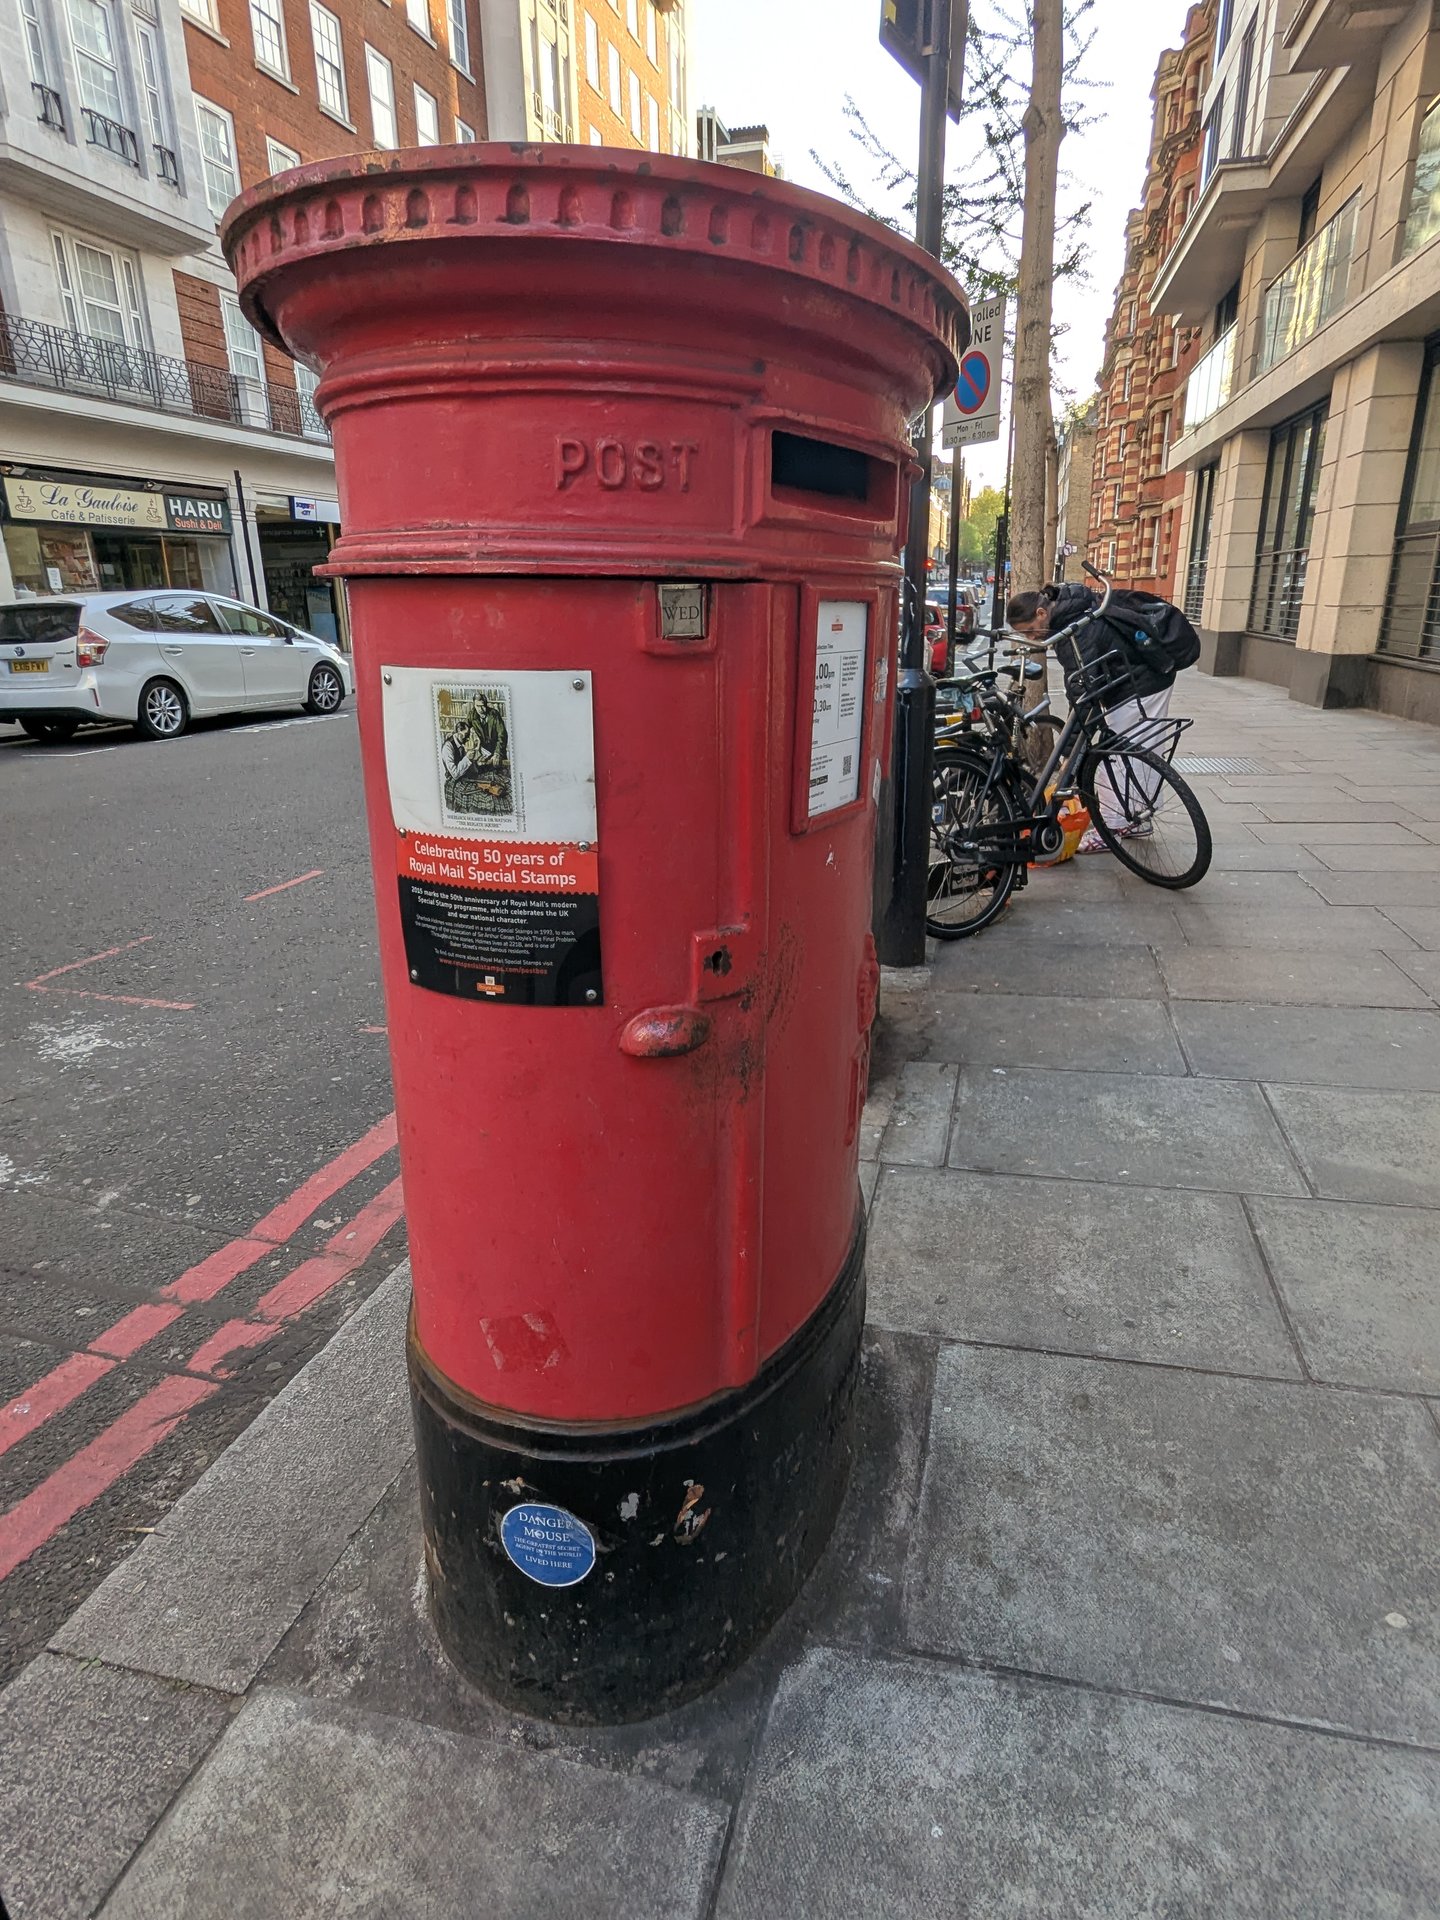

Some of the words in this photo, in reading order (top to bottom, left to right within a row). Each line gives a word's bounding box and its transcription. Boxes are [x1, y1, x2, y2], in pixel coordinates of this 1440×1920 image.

[957, 425, 968, 434] Mon
[555, 434, 699, 491] POST
[40, 484, 68, 506] La
[74, 488, 140, 512] Gauloise
[168, 498, 223, 519] HARU
[51, 510, 75, 520] Café
[79, 512, 86, 522] &
[88, 512, 136, 525] Patisserie
[174, 516, 198, 529] Sushi
[200, 520, 206, 529] &
[207, 520, 222, 530] Deli
[664, 606, 700, 620] WED
[414, 840, 479, 864] Celebrating
[484, 849, 500, 864] 50
[505, 853, 544, 866] years
[550, 852, 564, 866] of
[410, 857, 436, 875] Royal
[440, 862, 464, 879] Mail
[468, 866, 516, 883] Special
[521, 870, 576, 887] Stamps
[411, 886, 423, 894] 2015
[464, 896, 500, 906] anniversary
[510, 900, 528, 908] Royal
[418, 896, 435, 904] Special
[436, 899, 452, 909] Stamp
[454, 903, 489, 913] programme,
[431, 917, 444, 925] Holmes
[519, 1512, 574, 1529] DANGER
[524, 1526, 570, 1542] MOUSE
[515, 1543, 534, 1552] AGENT
[526, 1540, 555, 1550] GREATEST
[526, 1555, 548, 1566] LIVED
[551, 1560, 573, 1568] HERE
